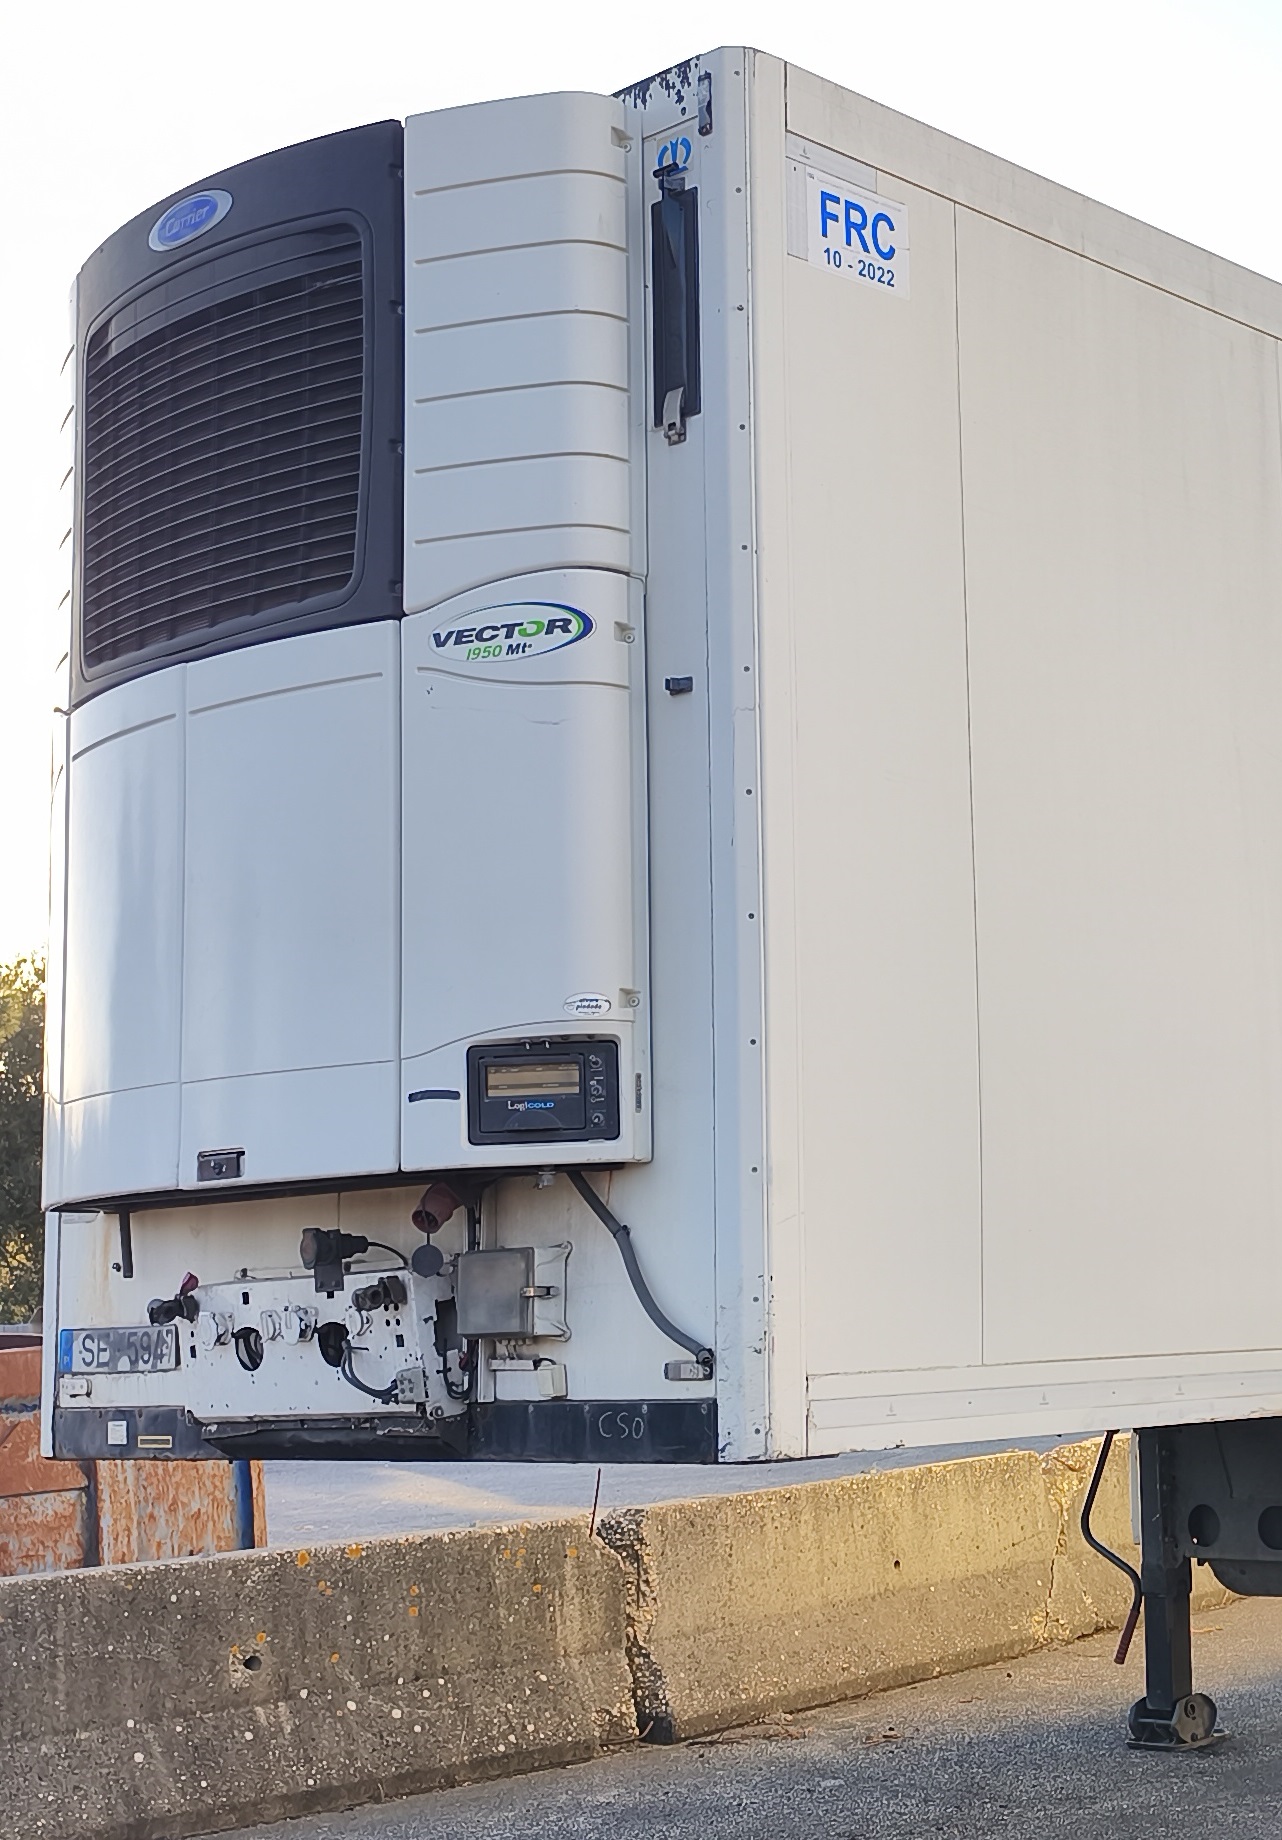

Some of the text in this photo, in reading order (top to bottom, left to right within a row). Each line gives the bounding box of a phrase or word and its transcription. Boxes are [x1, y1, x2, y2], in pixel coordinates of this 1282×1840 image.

[165, 205, 210, 237] Carrier
[820, 190, 896, 261] FRC
[823, 247, 842, 269] 10
[857, 259, 896, 288] 2022
[432, 617, 573, 648] VECTOR
[466, 644, 503, 661] 1950
